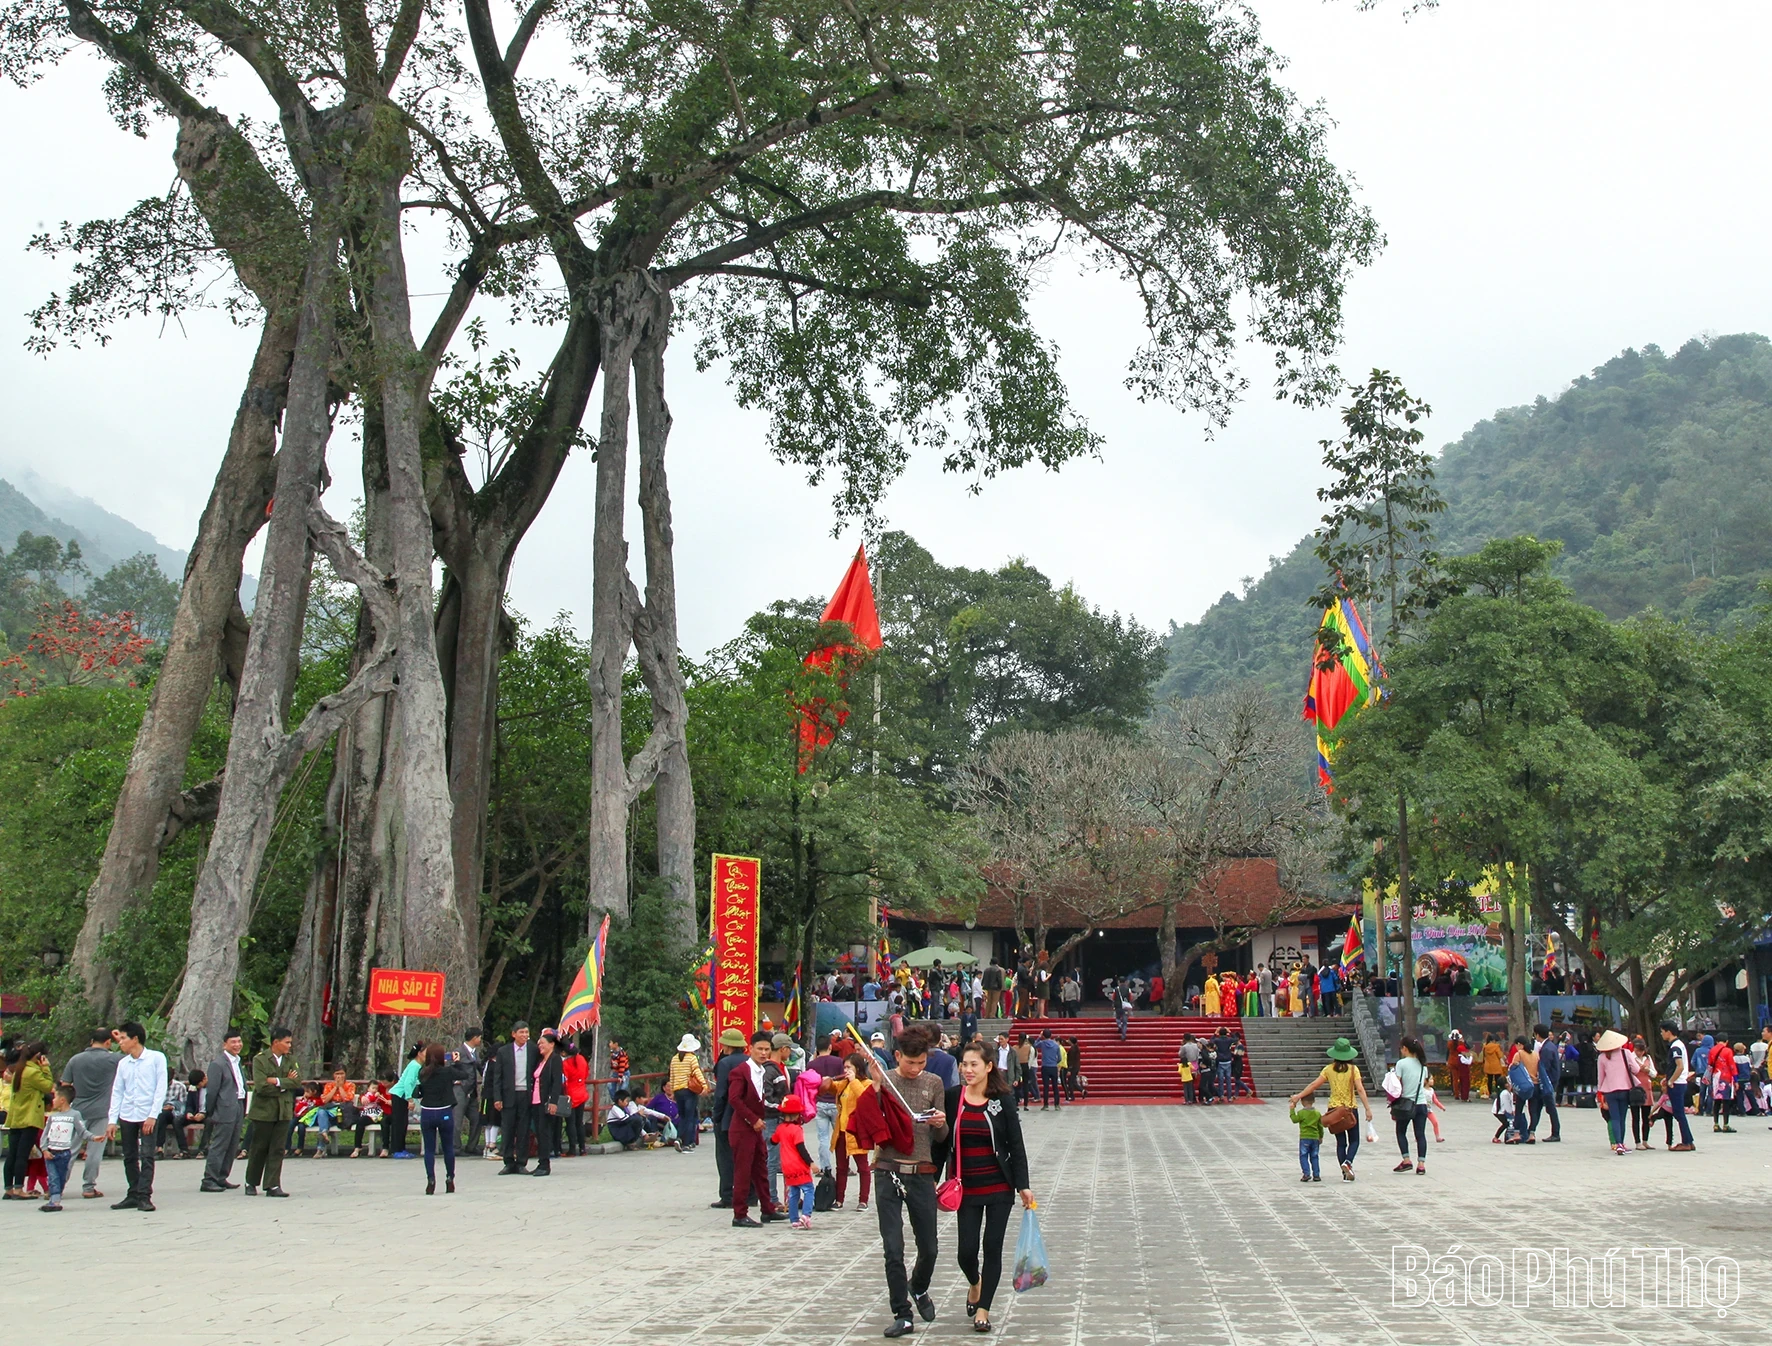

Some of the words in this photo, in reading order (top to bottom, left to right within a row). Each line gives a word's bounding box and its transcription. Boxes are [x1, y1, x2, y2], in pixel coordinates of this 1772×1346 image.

[724, 878, 750, 892] Thiên
[724, 947, 746, 958] Con
[377, 976, 399, 995] NHÀ
[402, 976, 423, 996] SẮP
[424, 977, 437, 998] LỄ
